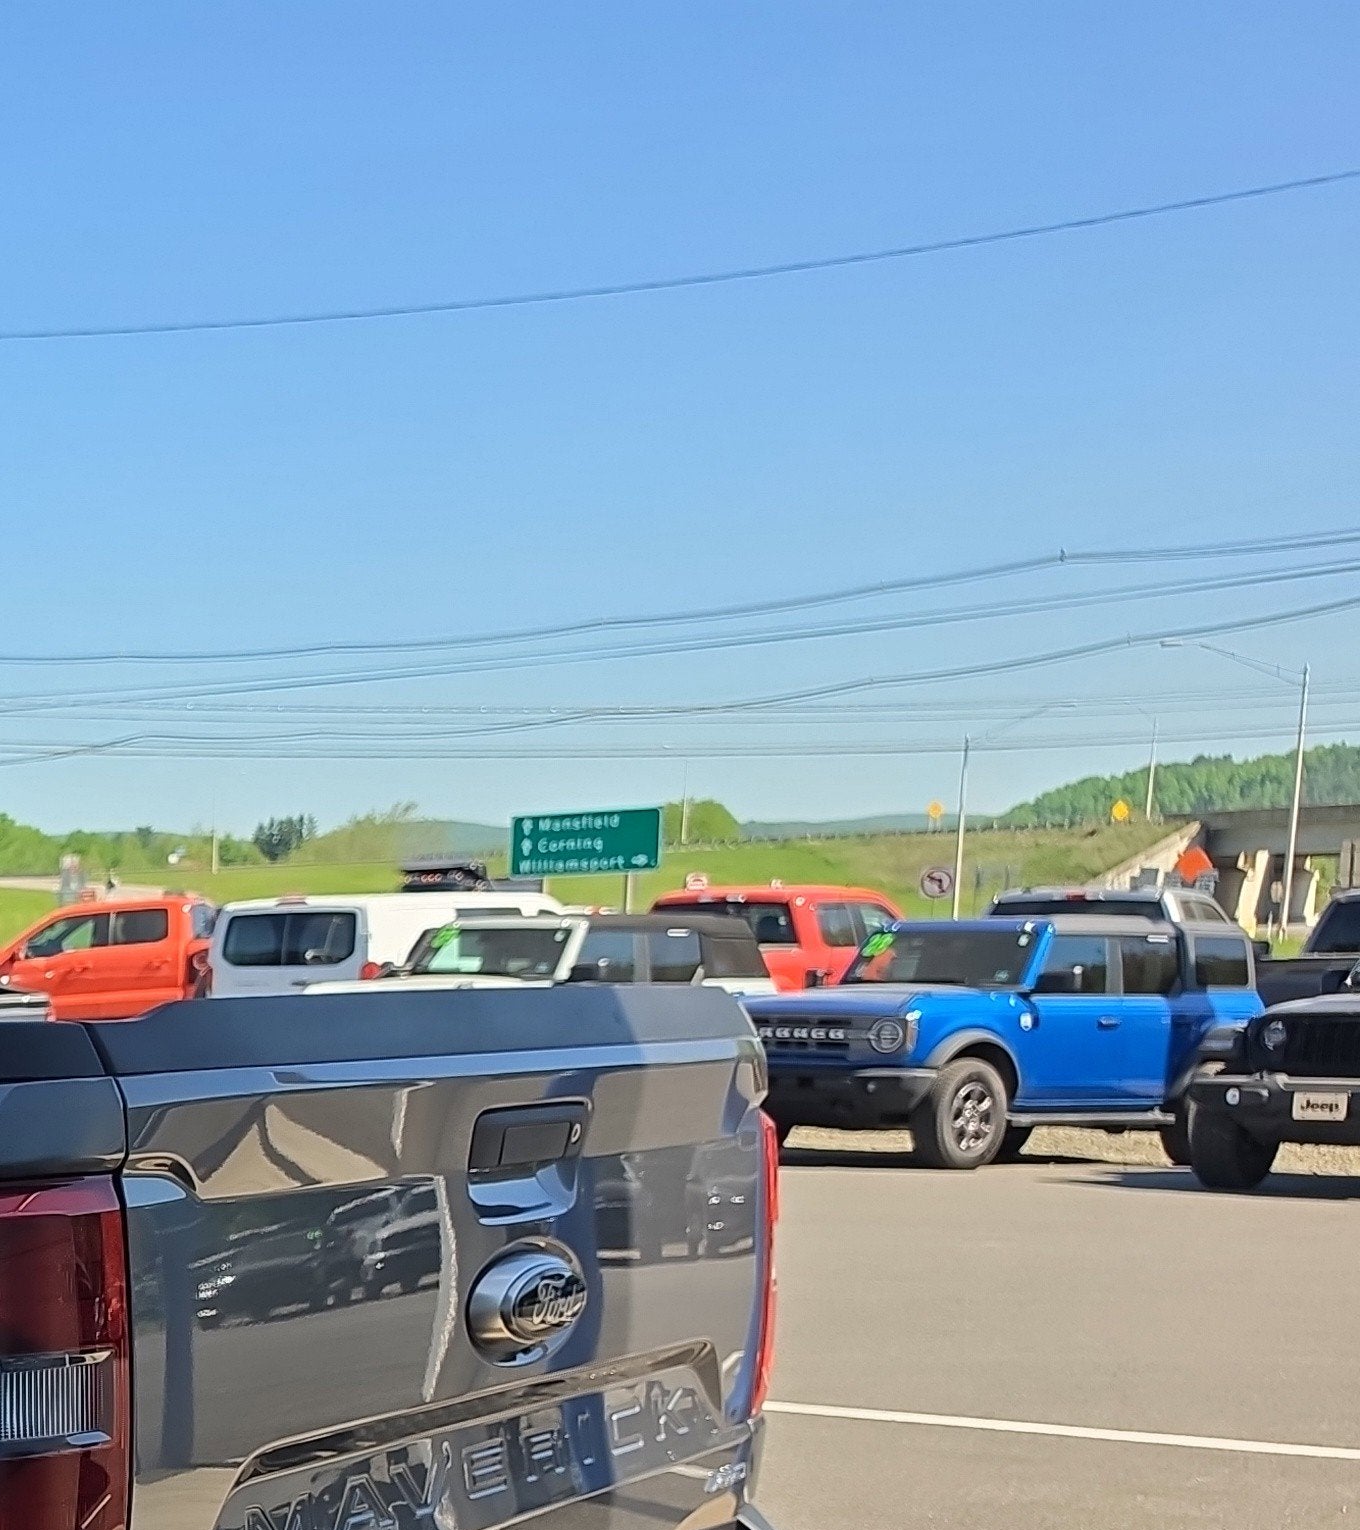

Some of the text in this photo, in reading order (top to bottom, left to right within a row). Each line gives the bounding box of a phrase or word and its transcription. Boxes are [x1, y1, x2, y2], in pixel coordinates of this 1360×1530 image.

[538, 813, 621, 832] Mansfield
[537, 837, 604, 853] Corning
[519, 855, 626, 873] Williamsport
[759, 1026, 845, 1040] RONCO
[1300, 1099, 1340, 1113] Jeep
[533, 1279, 583, 1325] Ford
